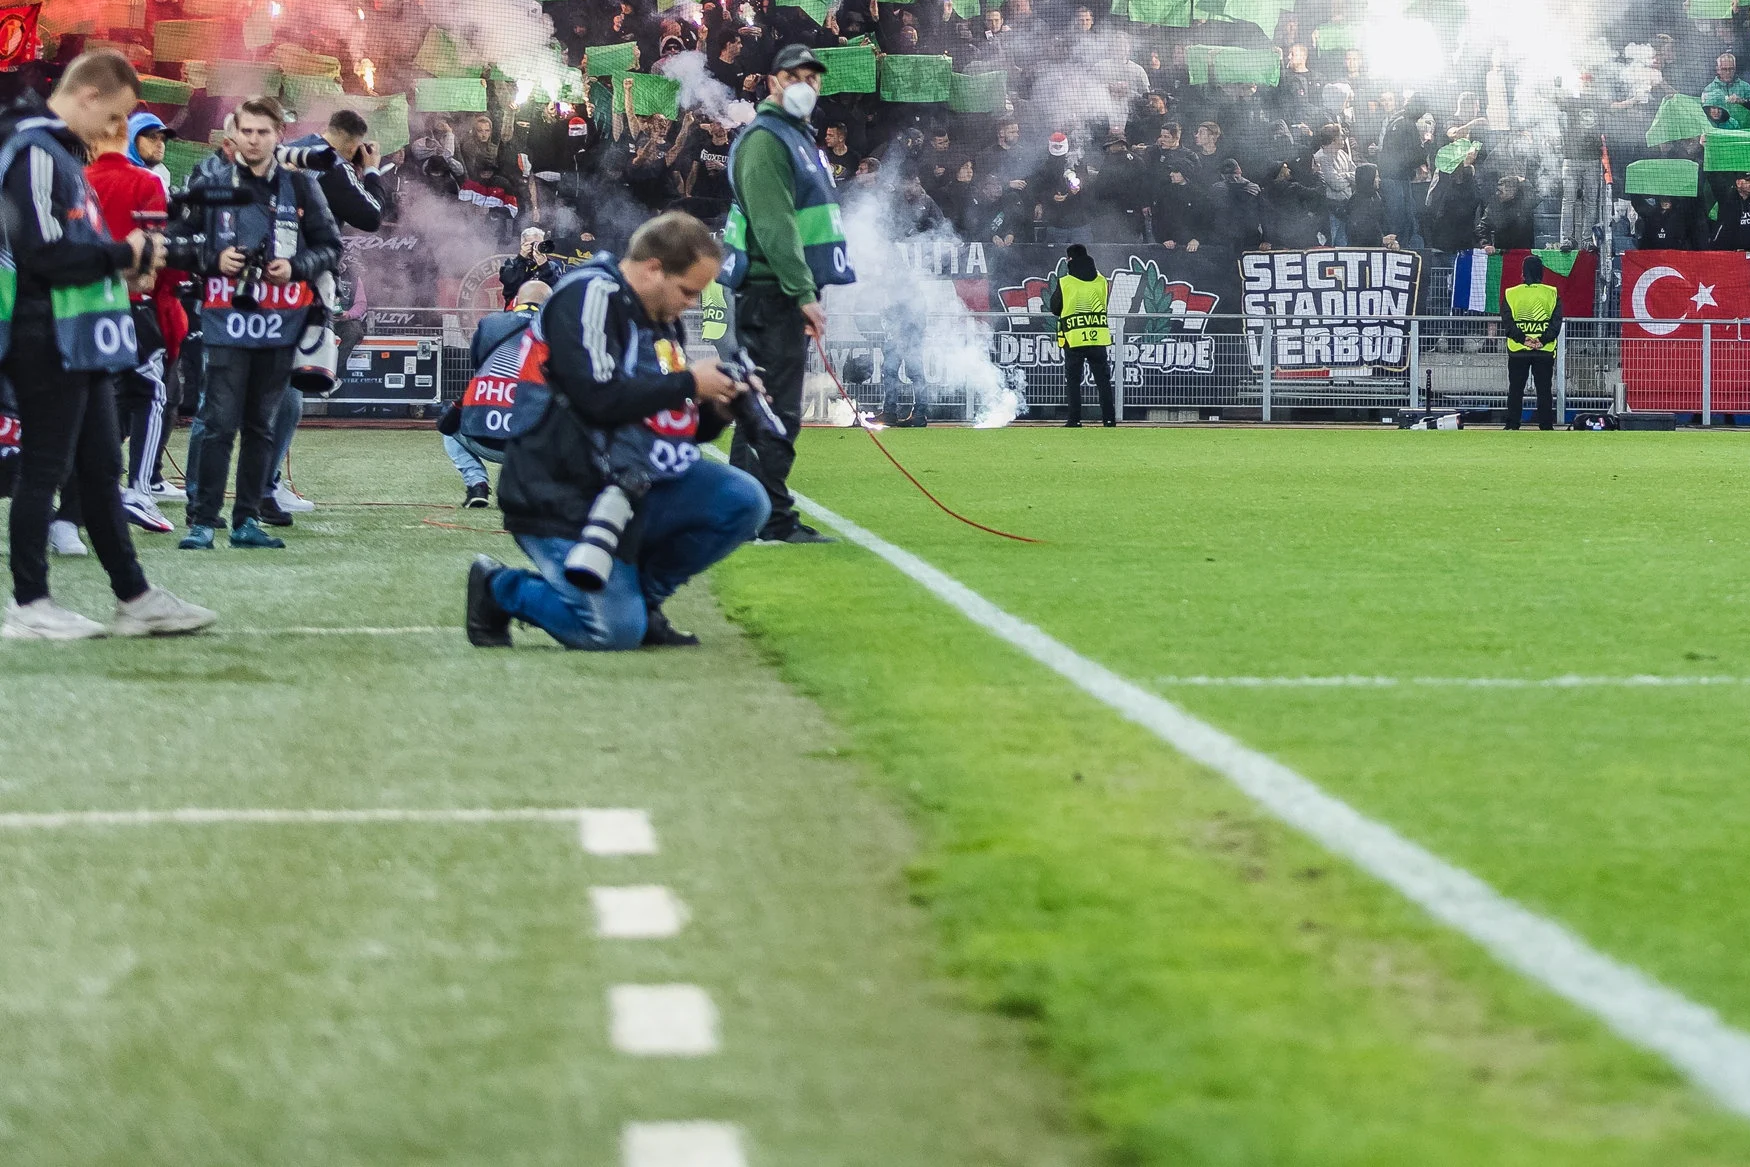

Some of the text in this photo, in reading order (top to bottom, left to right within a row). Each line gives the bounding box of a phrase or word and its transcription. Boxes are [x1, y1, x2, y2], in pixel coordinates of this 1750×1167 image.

[1242, 252, 1413, 290] SECTIE
[226, 312, 283, 339] 002
[1066, 315, 1107, 329] STEWAR
[1244, 290, 1409, 326] STADION
[1246, 326, 1404, 366] VERBOD
